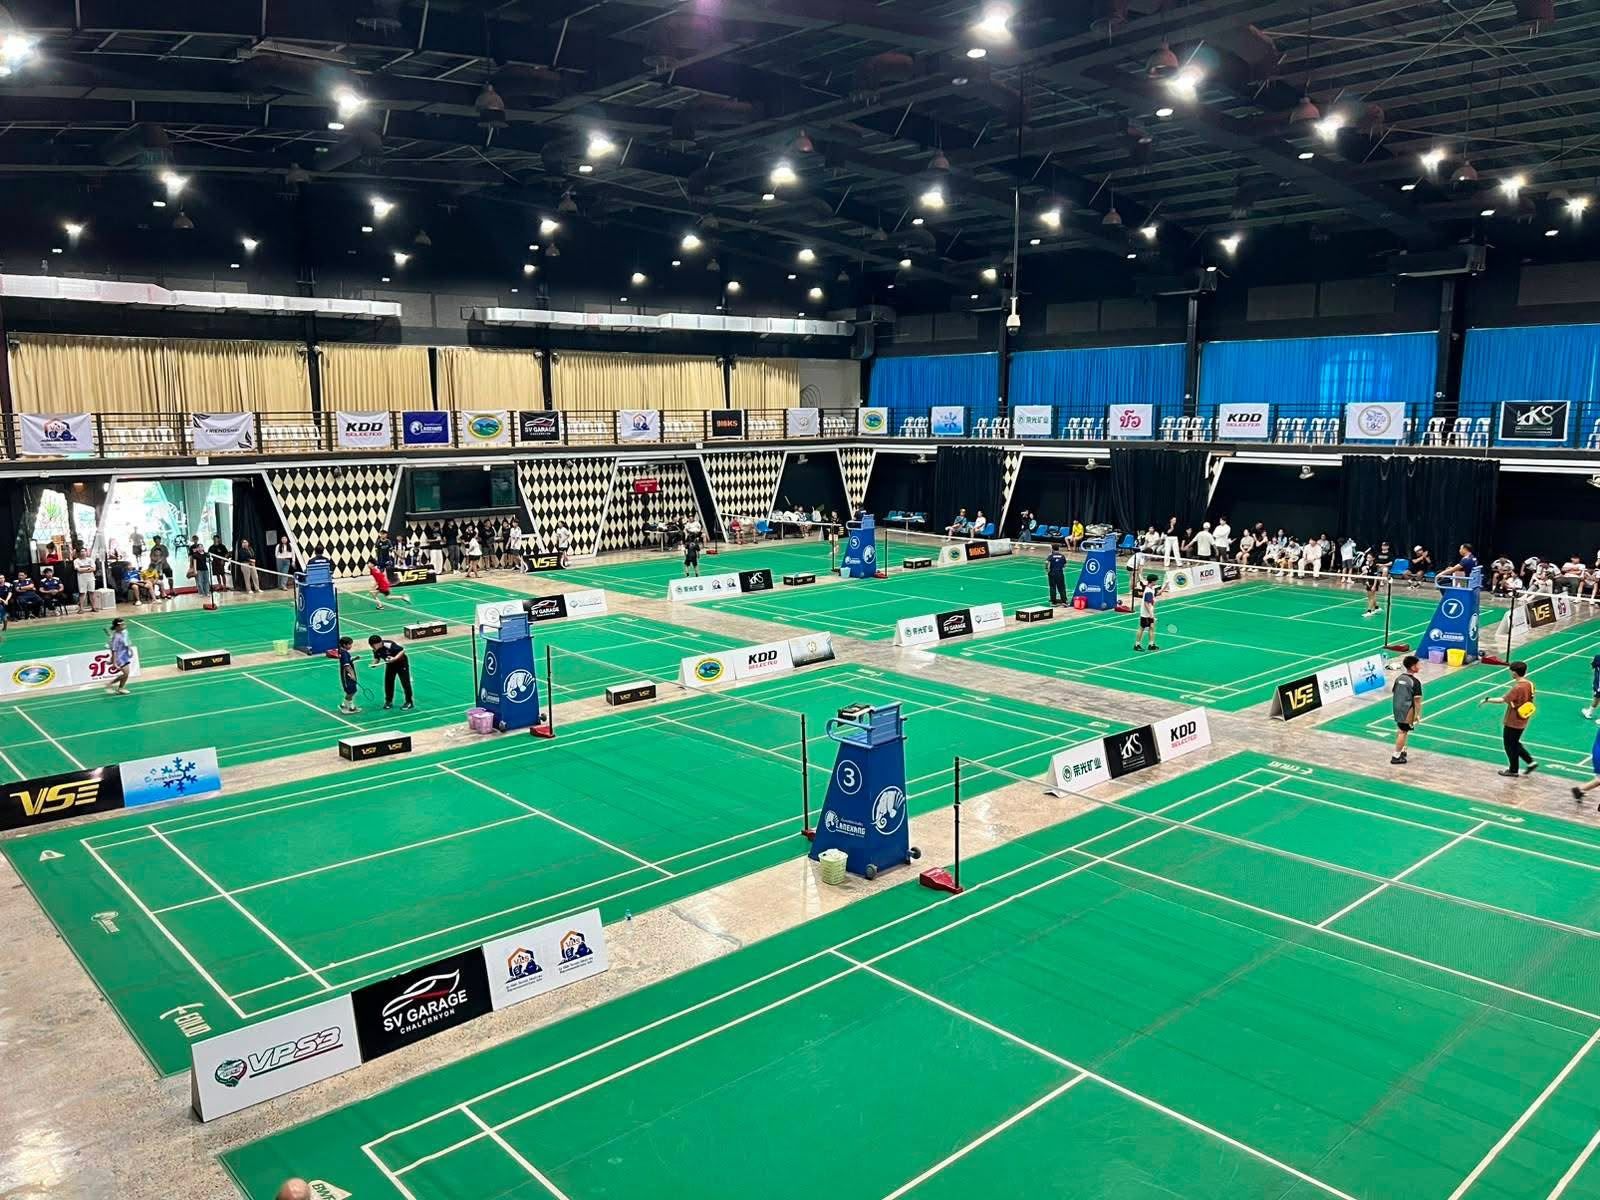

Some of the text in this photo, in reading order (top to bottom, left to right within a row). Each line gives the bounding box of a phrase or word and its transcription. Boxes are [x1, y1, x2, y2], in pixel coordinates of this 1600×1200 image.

[1227, 413, 1262, 422] KDD
[346, 422, 383, 432] KDD
[852, 538, 857, 546] 5
[529, 556, 558, 568] VSE
[1090, 562, 1096, 571] 6
[1200, 569, 1214, 578] KDD
[1448, 602, 1458, 614] 7
[1532, 604, 1550, 622] VSE
[488, 656, 494, 670] 2
[748, 650, 778, 664] KDD
[1285, 683, 1313, 710] VSE
[1170, 721, 1196, 742] KDD
[1073, 758, 1102, 777] 荣光矿业
[844, 768, 855, 787] 3
[10, 778, 103, 816] VSE
[384, 989, 468, 1032] SV GARAGE
[400, 1008, 455, 1034] CHALERNYON
[248, 1026, 341, 1072] VPS3
